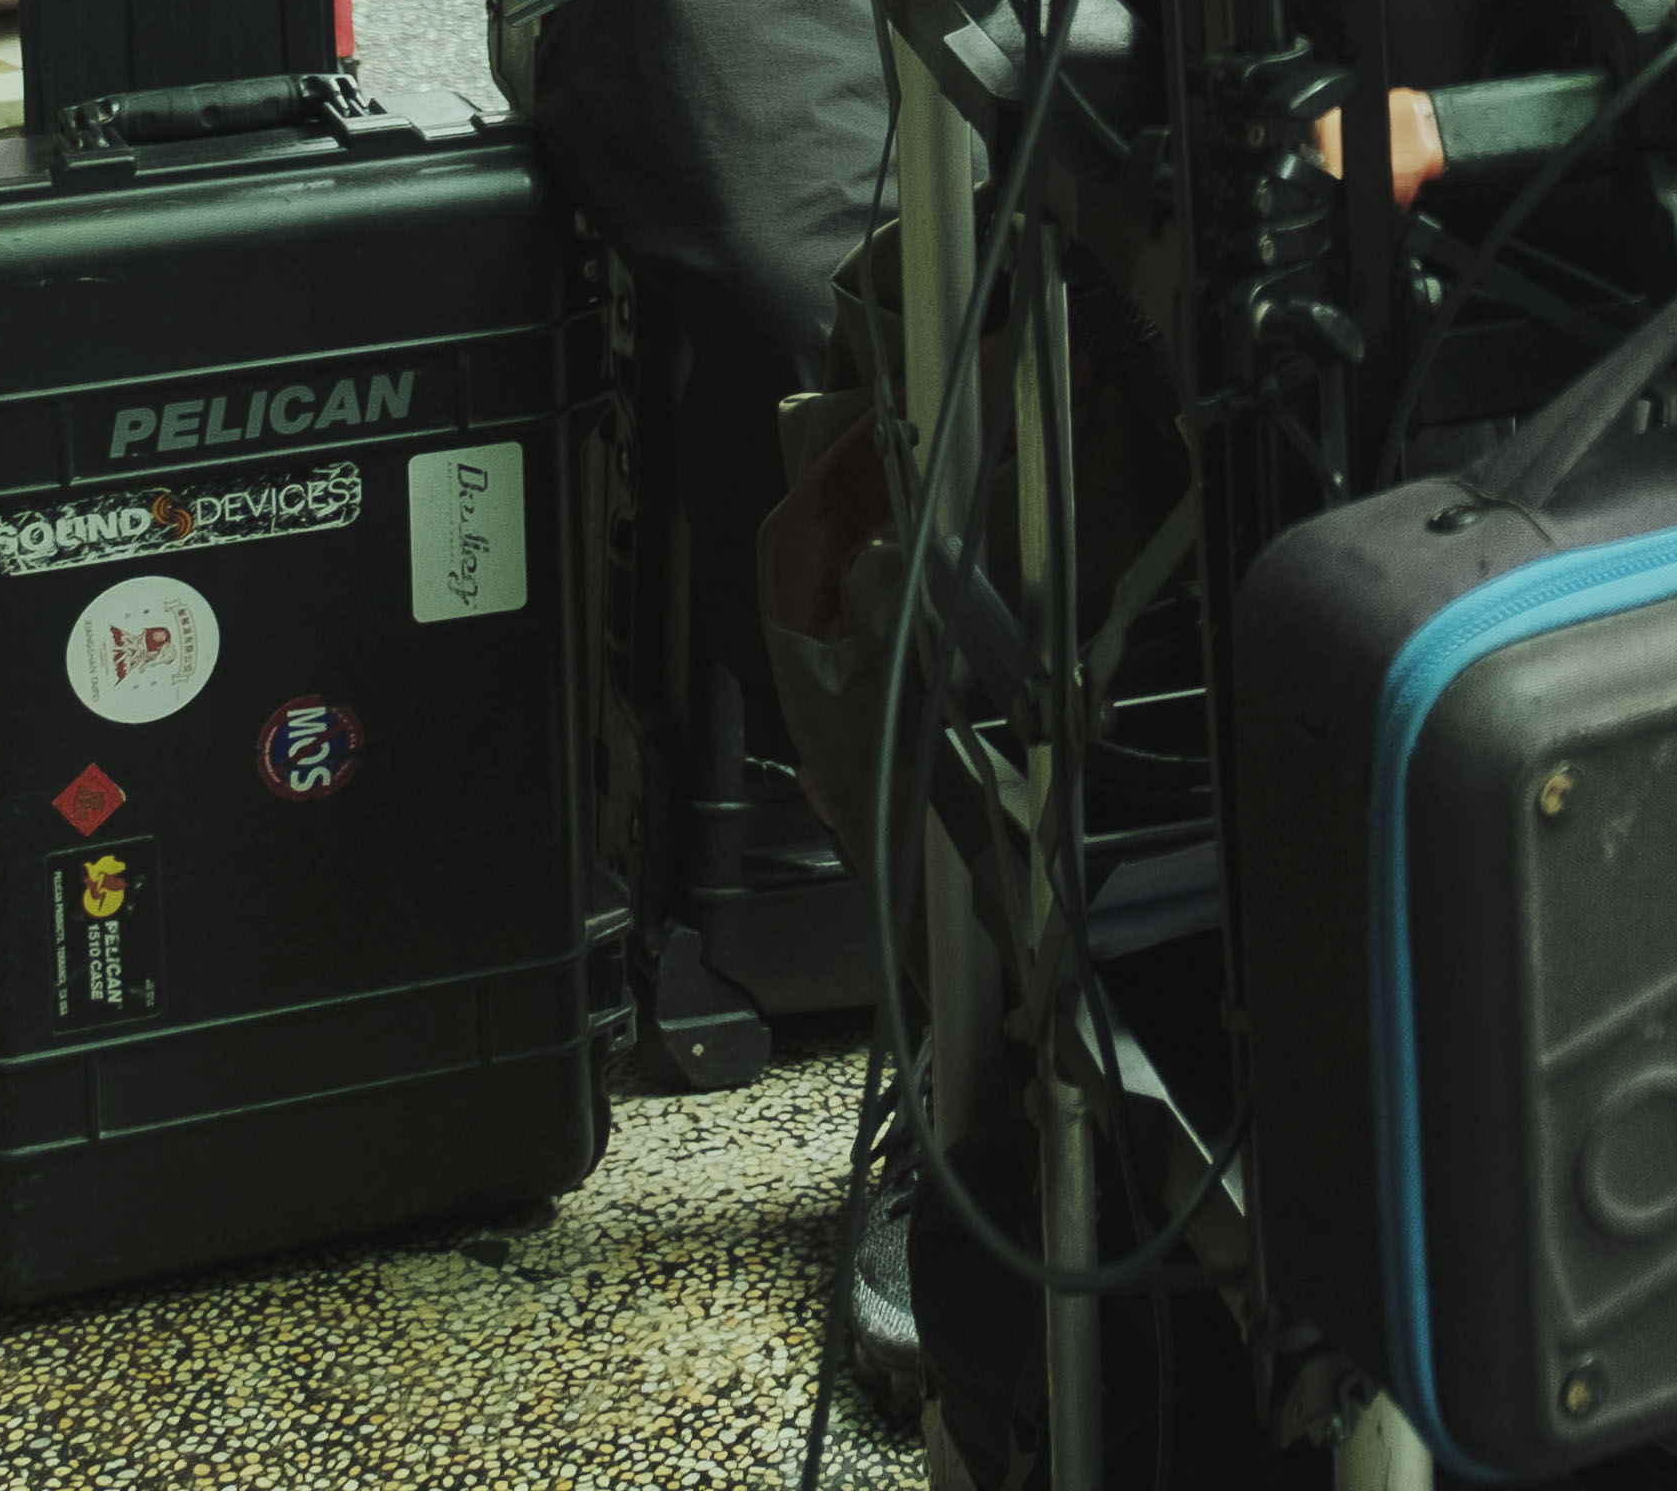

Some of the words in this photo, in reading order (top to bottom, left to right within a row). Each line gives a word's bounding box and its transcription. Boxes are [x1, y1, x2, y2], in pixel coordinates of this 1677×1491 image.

[109, 371, 415, 459] PELICAN
[196, 477, 350, 526] DEVICES
[285, 705, 332, 793] MOS
[87, 922, 102, 958] 1510
[89, 960, 104, 1001] CASE
